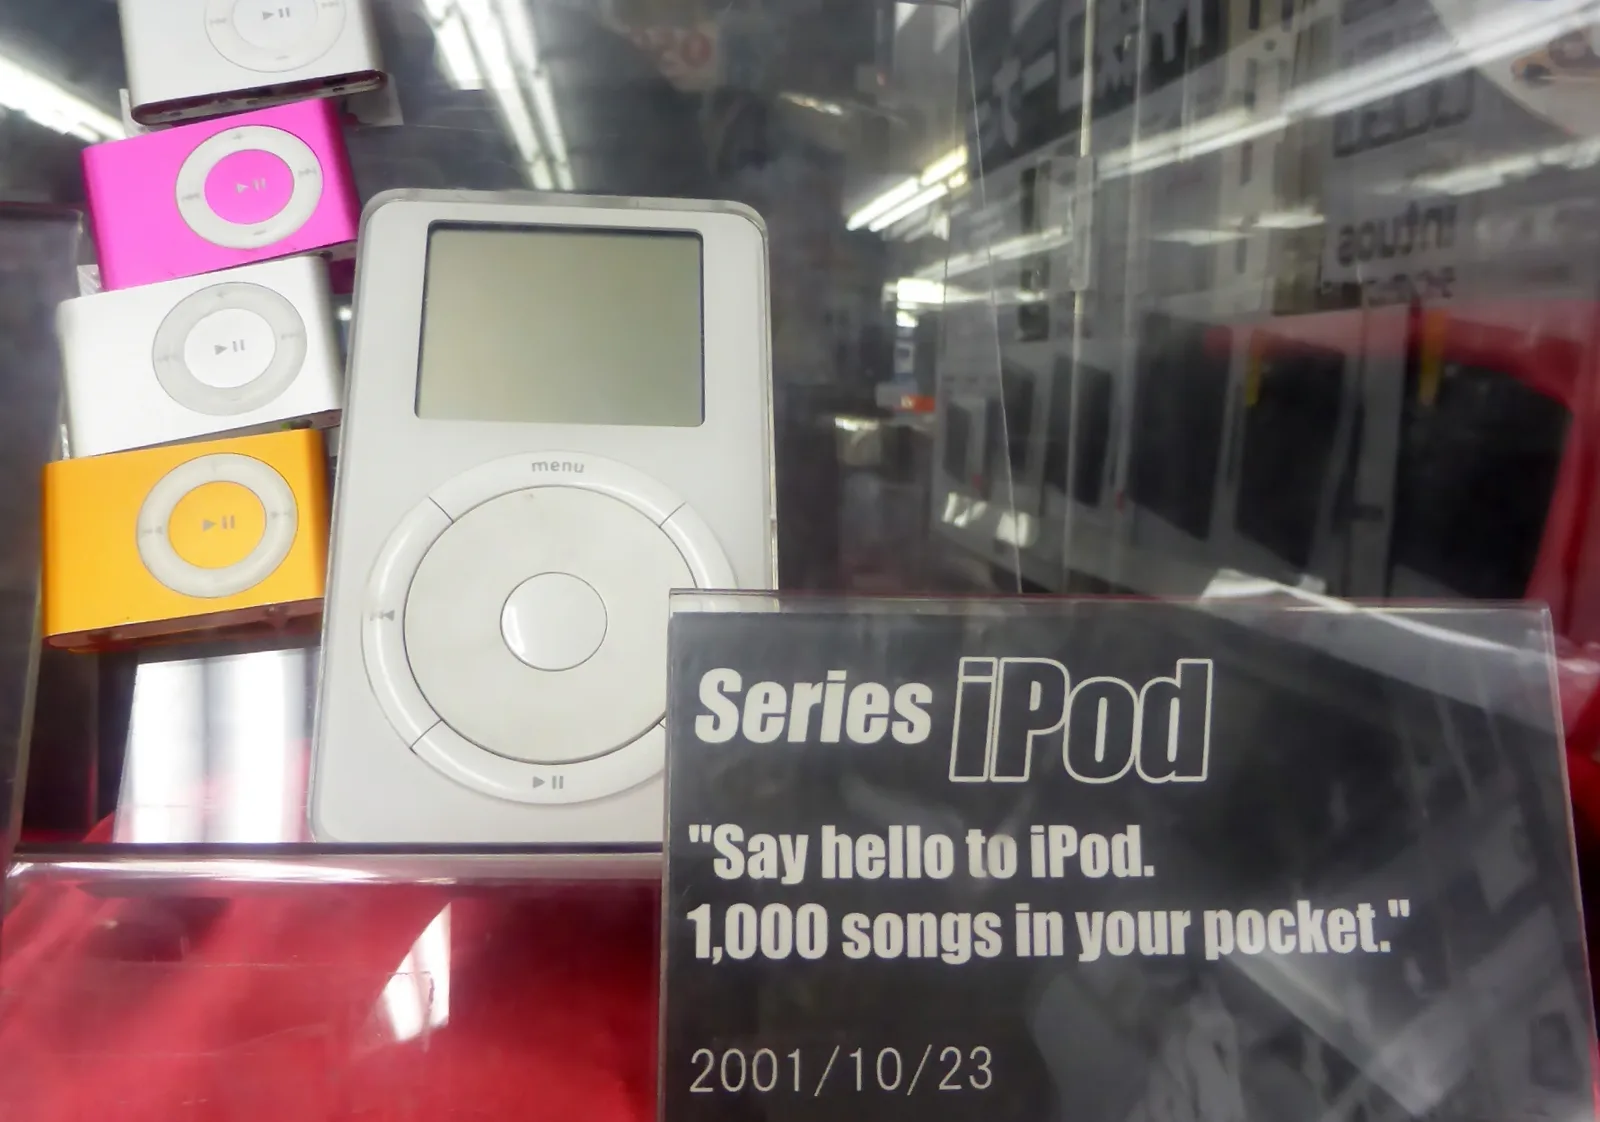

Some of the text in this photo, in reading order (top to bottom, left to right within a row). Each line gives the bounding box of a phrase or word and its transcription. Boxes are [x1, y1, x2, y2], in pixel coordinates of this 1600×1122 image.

[531, 460, 585, 474] menu
[695, 657, 1213, 783] Series iPod
[688, 824, 1155, 885] "Say hello to iPod.
[687, 899, 1411, 965] 1,000 songs in your pocket."
[689, 1044, 994, 1097] 2001/10/23
